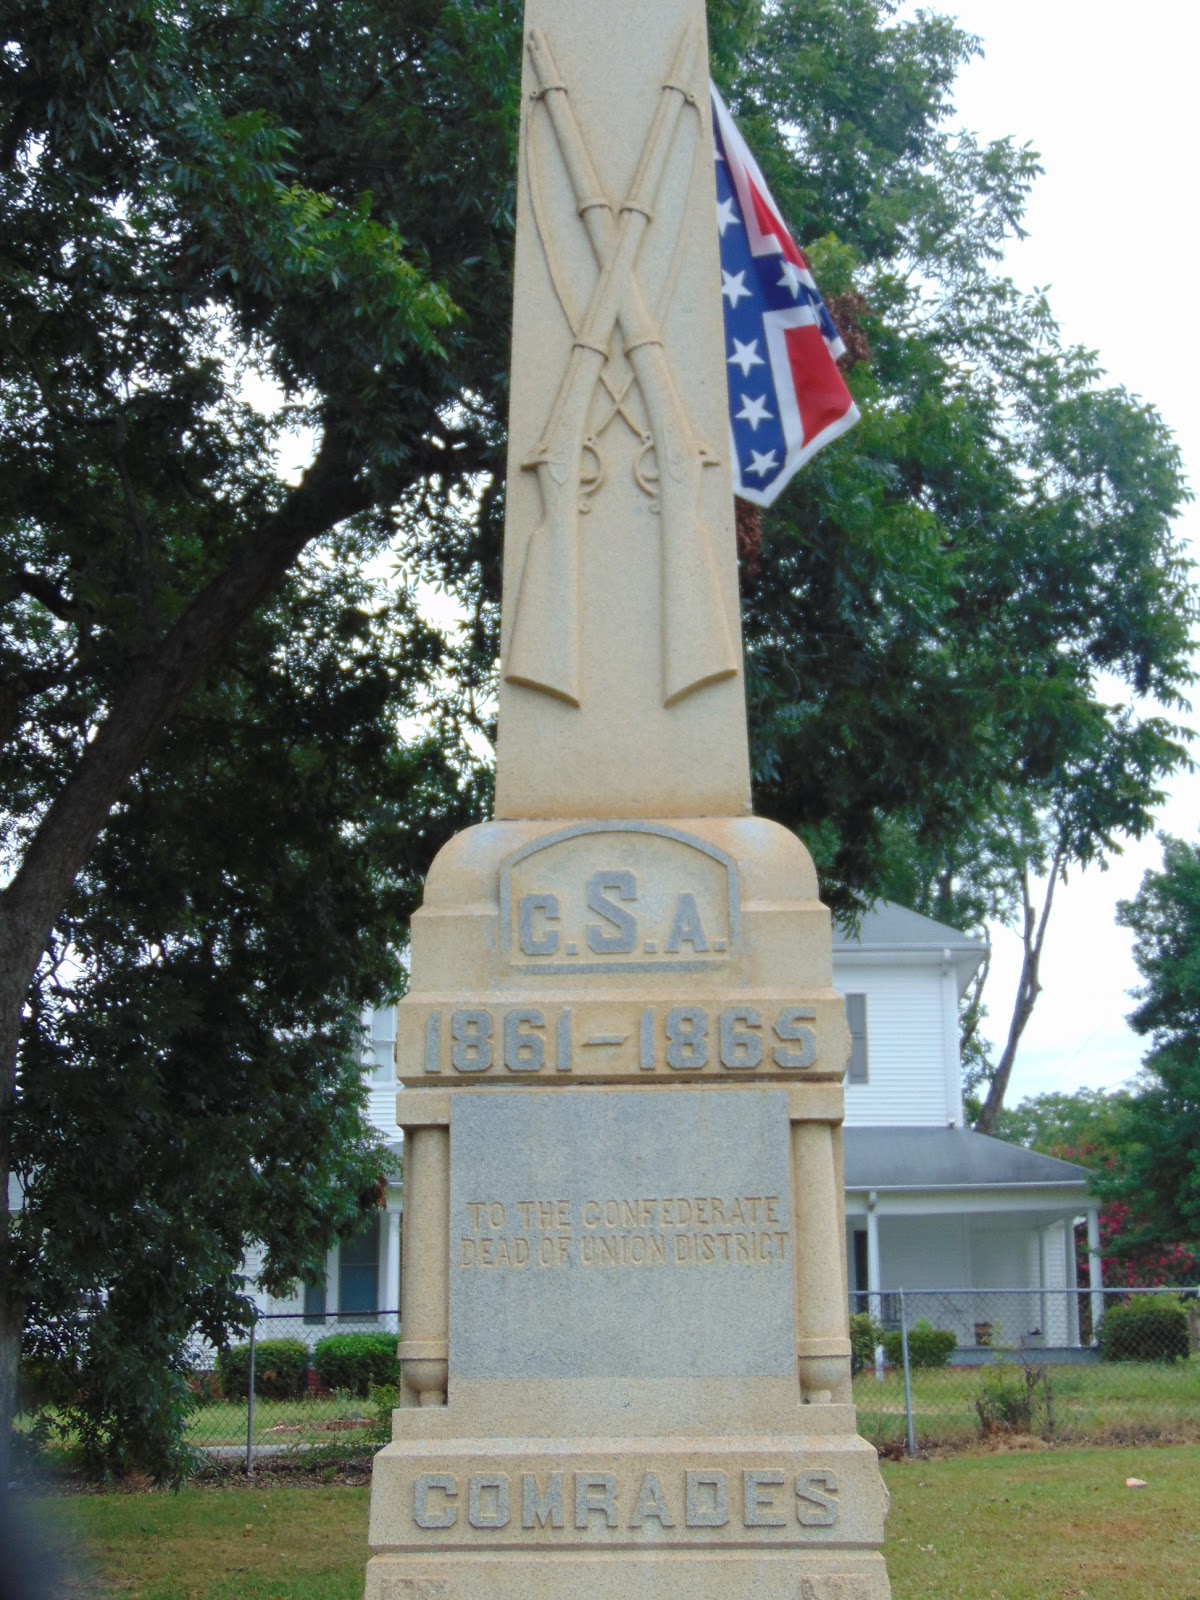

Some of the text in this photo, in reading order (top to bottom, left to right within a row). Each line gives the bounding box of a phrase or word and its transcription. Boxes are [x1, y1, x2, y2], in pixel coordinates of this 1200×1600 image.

[519, 868, 728, 956] C.S.A.
[465, 1196, 780, 1232] TO THE CONFEDERATE
[459, 1231, 790, 1269] DEAD OF UNION DISTRICT
[412, 1467, 840, 1529] COMRADES
